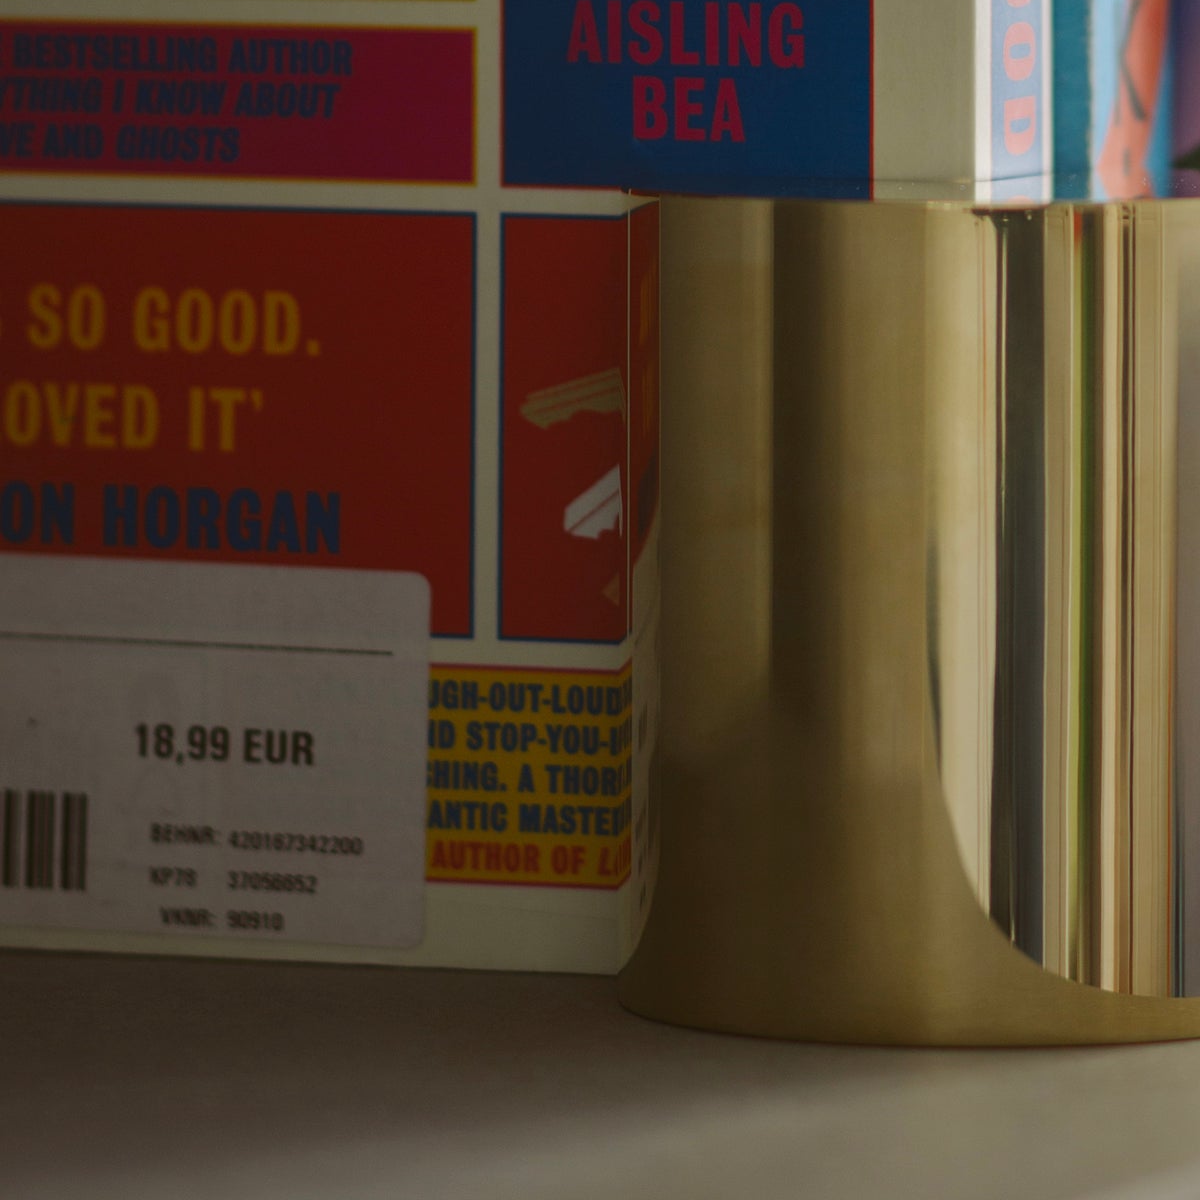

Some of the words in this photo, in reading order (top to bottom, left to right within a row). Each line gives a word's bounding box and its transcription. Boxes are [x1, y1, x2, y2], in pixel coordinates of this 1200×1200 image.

[13, 33, 218, 74] BESTSELLING
[228, 39, 352, 76] AUTHOR
[566, 0, 805, 69] AISLING
[113, 81, 123, 112] I
[135, 80, 227, 115] KNOW
[233, 82, 340, 119] ABOUT
[631, 75, 746, 143] BEA
[43, 123, 103, 160] AND
[115, 124, 240, 163] GHOSTS
[27, 283, 105, 350] SO
[134, 286, 321, 357] GOOD.
[4, 380, 159, 450] OVED
[0, 478, 75, 544] ON
[103, 484, 340, 554] HORGAN
[135, 723, 230, 765] 18,99
[244, 728, 315, 766] EUR
[518, 764, 535, 793] A
[428, 800, 508, 832] ANTIC
[432, 840, 540, 874] AUTHOR
[551, 844, 587, 875] OF
